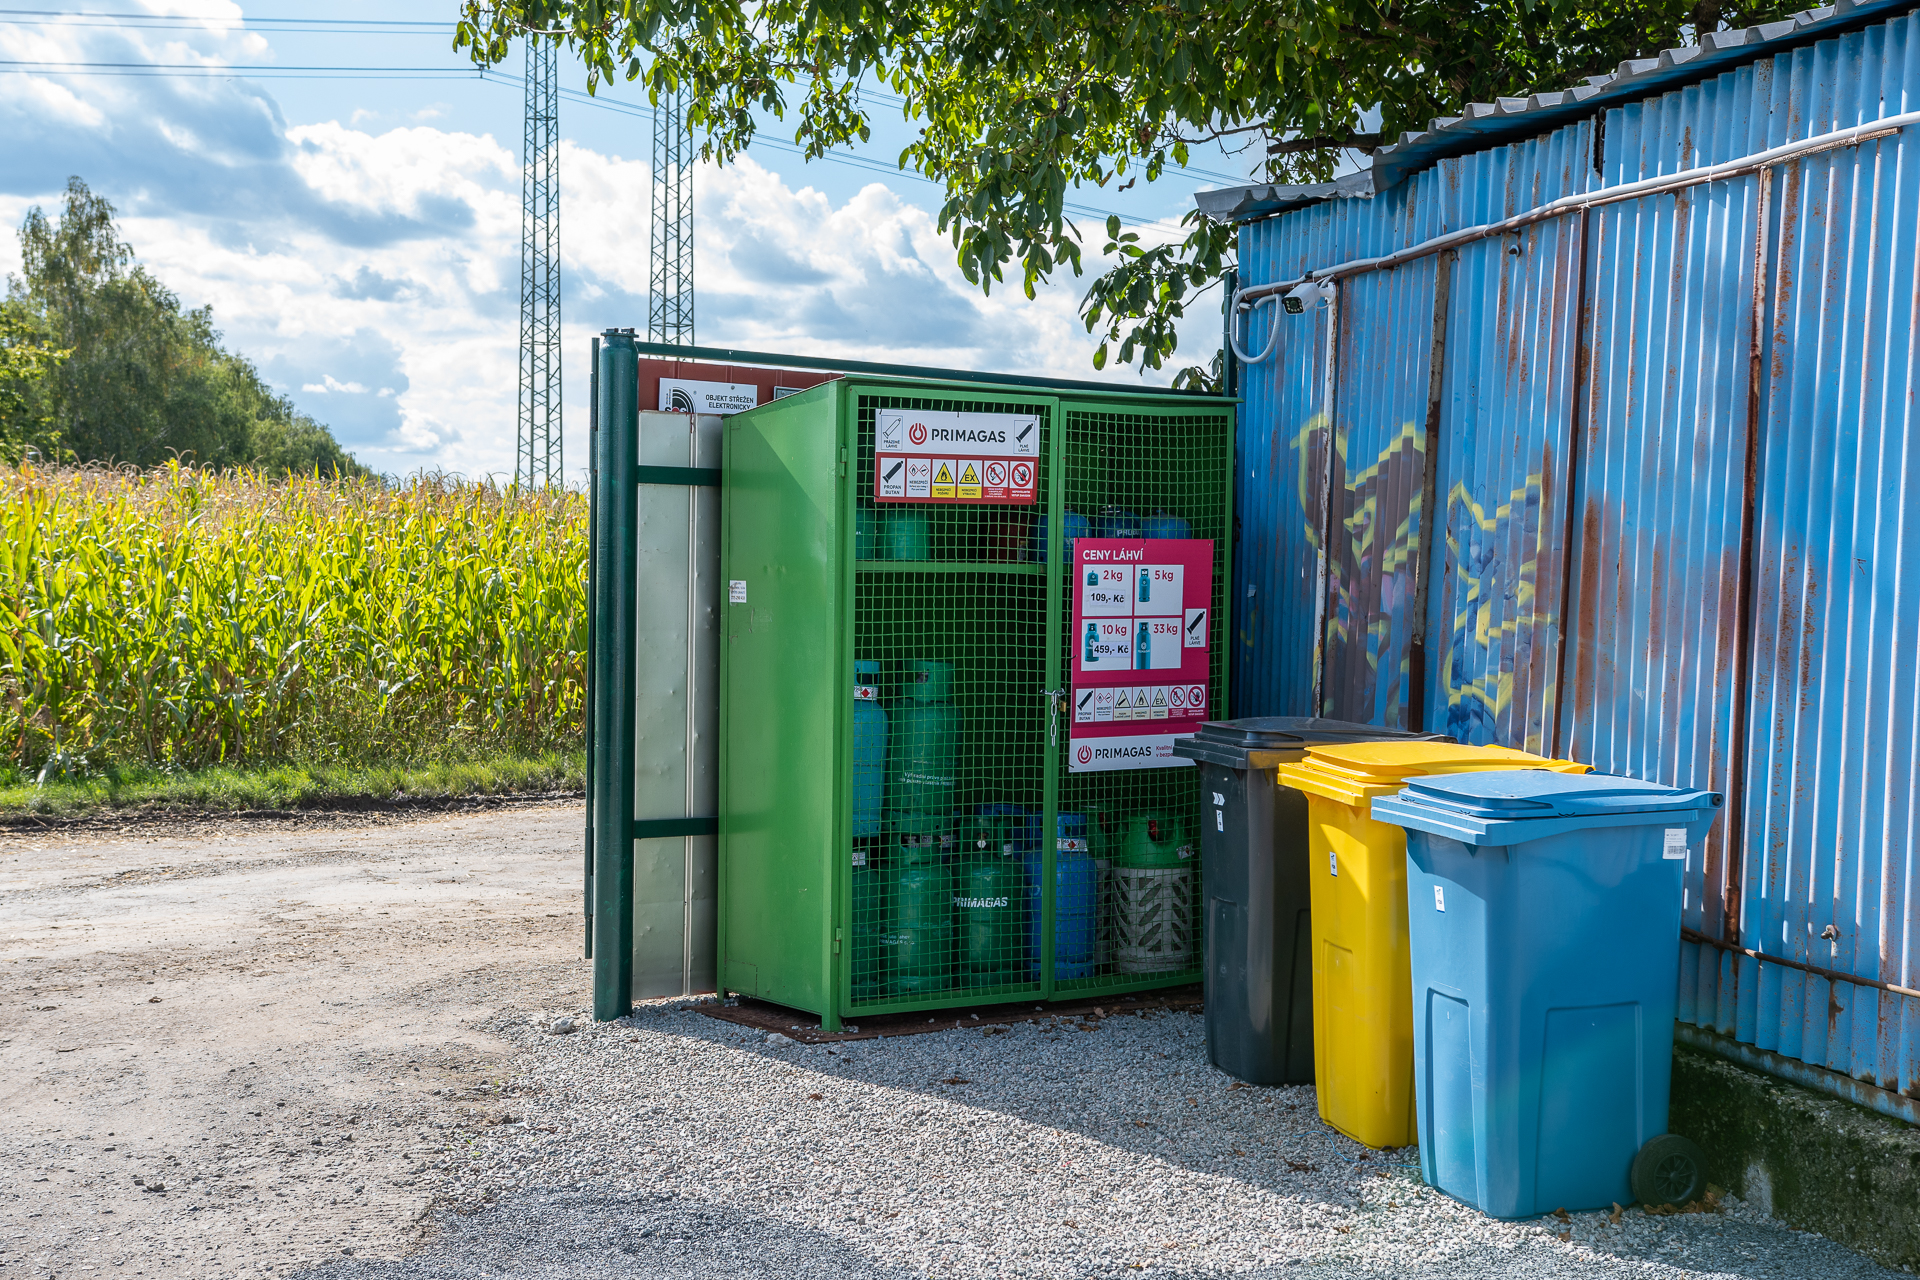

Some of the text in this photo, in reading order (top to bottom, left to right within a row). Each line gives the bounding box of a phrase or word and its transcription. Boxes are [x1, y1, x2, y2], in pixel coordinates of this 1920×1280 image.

[705, 394, 754, 404] OBJEKT STŘEŽEN
[708, 401, 751, 410] ELEKTRONICKY
[931, 428, 1006, 443] PRIMAGAS
[964, 474, 975, 482] EX
[1082, 548, 1144, 560] CENY LÁHVÍ
[1102, 569, 1123, 582] 2 kg
[1154, 569, 1174, 582] 5 kg
[1090, 592, 1124, 603] 109,- Kč
[1102, 624, 1127, 637] 10 kg
[1153, 623, 1178, 636] 33 kg
[1094, 645, 1115, 656] 459,-
[1117, 645, 1129, 654] Kč
[1095, 746, 1152, 759] PRIMAGAS
[953, 896, 1008, 908] PRIMAGAS
